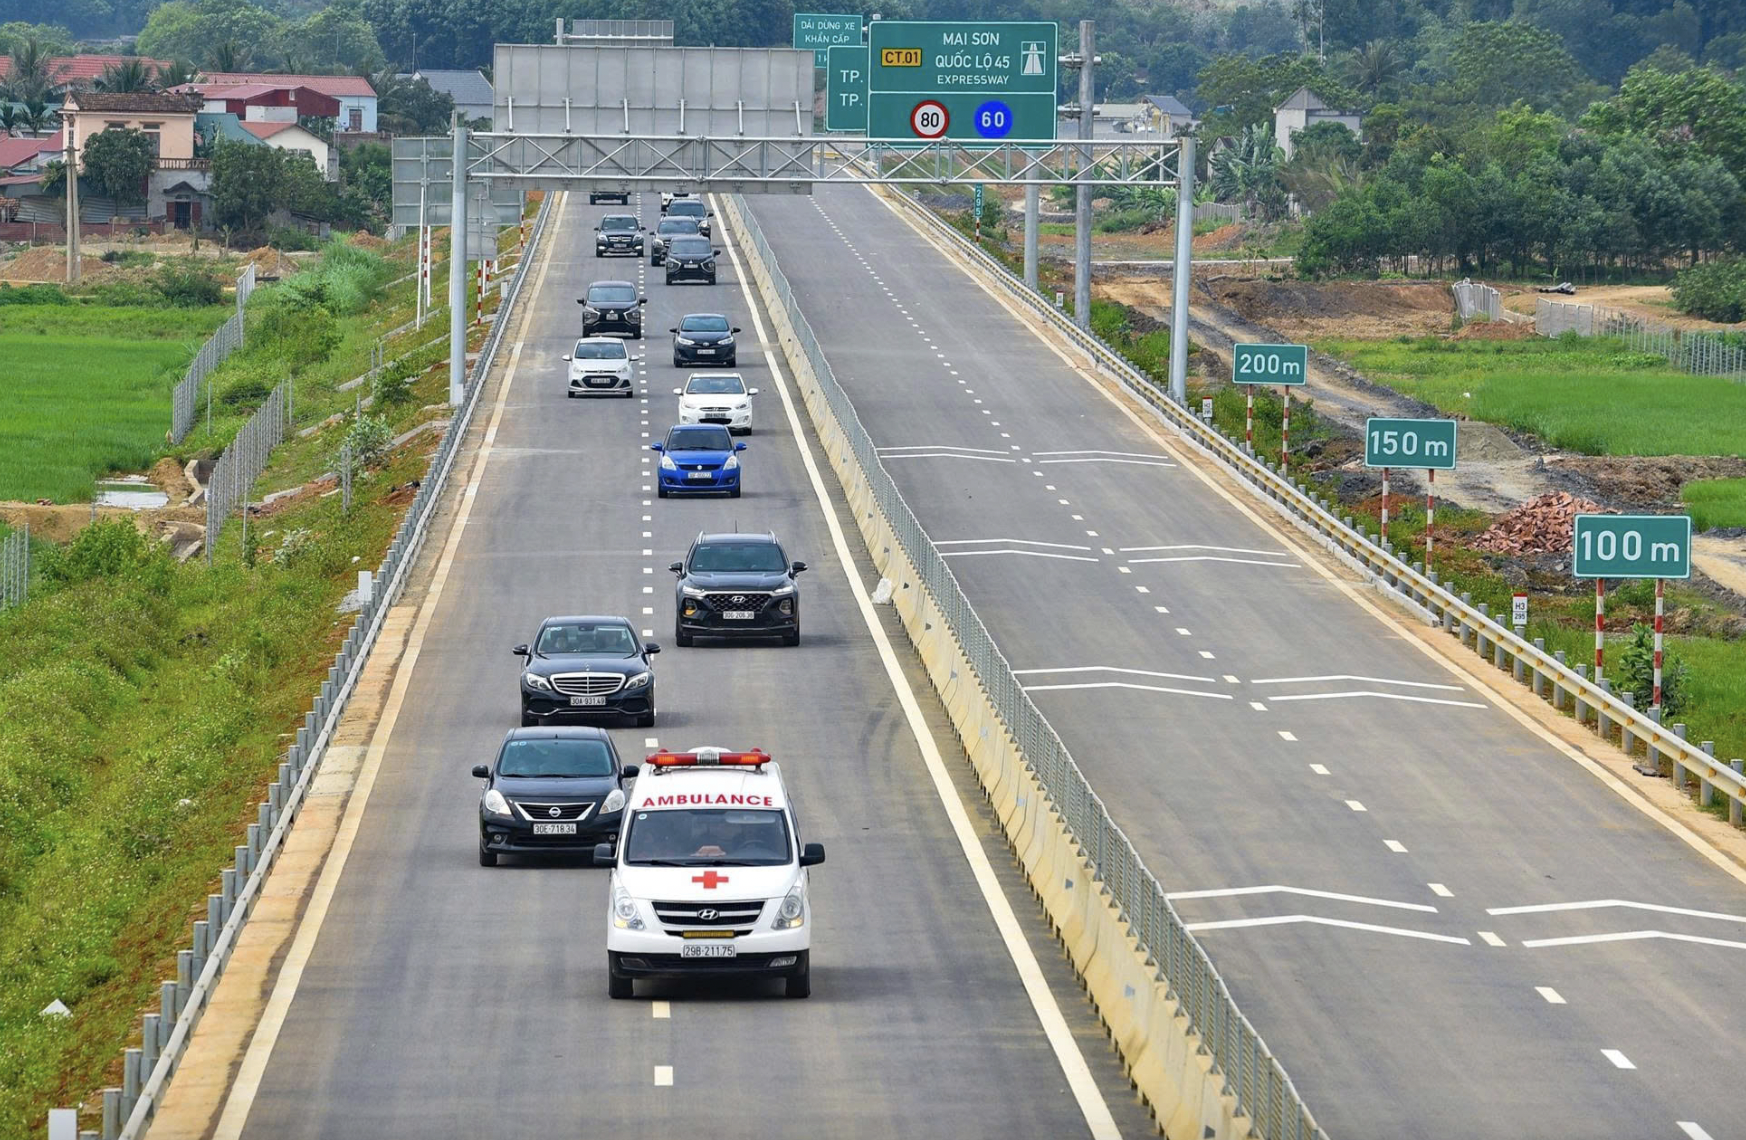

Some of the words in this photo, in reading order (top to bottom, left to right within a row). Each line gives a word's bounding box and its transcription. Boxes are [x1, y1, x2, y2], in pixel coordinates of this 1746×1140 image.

[844, 22, 856, 31] XE
[943, 32, 968, 46] MAI
[971, 31, 1000, 46] SƠN
[885, 51, 919, 64] CT.01
[935, 49, 972, 68] QUỐC
[975, 52, 992, 71] LỘ
[994, 55, 1010, 69] 45
[840, 70, 863, 83] TP.
[937, 75, 1010, 85] EXPRESSWAY
[839, 93, 863, 107] TP.
[920, 112, 940, 128] 80
[981, 111, 1005, 128] 60
[1239, 353, 1280, 374] 200
[1282, 361, 1300, 375] m
[1370, 430, 1418, 455] 150
[1424, 440, 1448, 457] m
[1581, 530, 1642, 561] 100
[1650, 542, 1680, 562] m
[1515, 602, 1525, 610] H3
[642, 793, 773, 808] AMBULANCE
